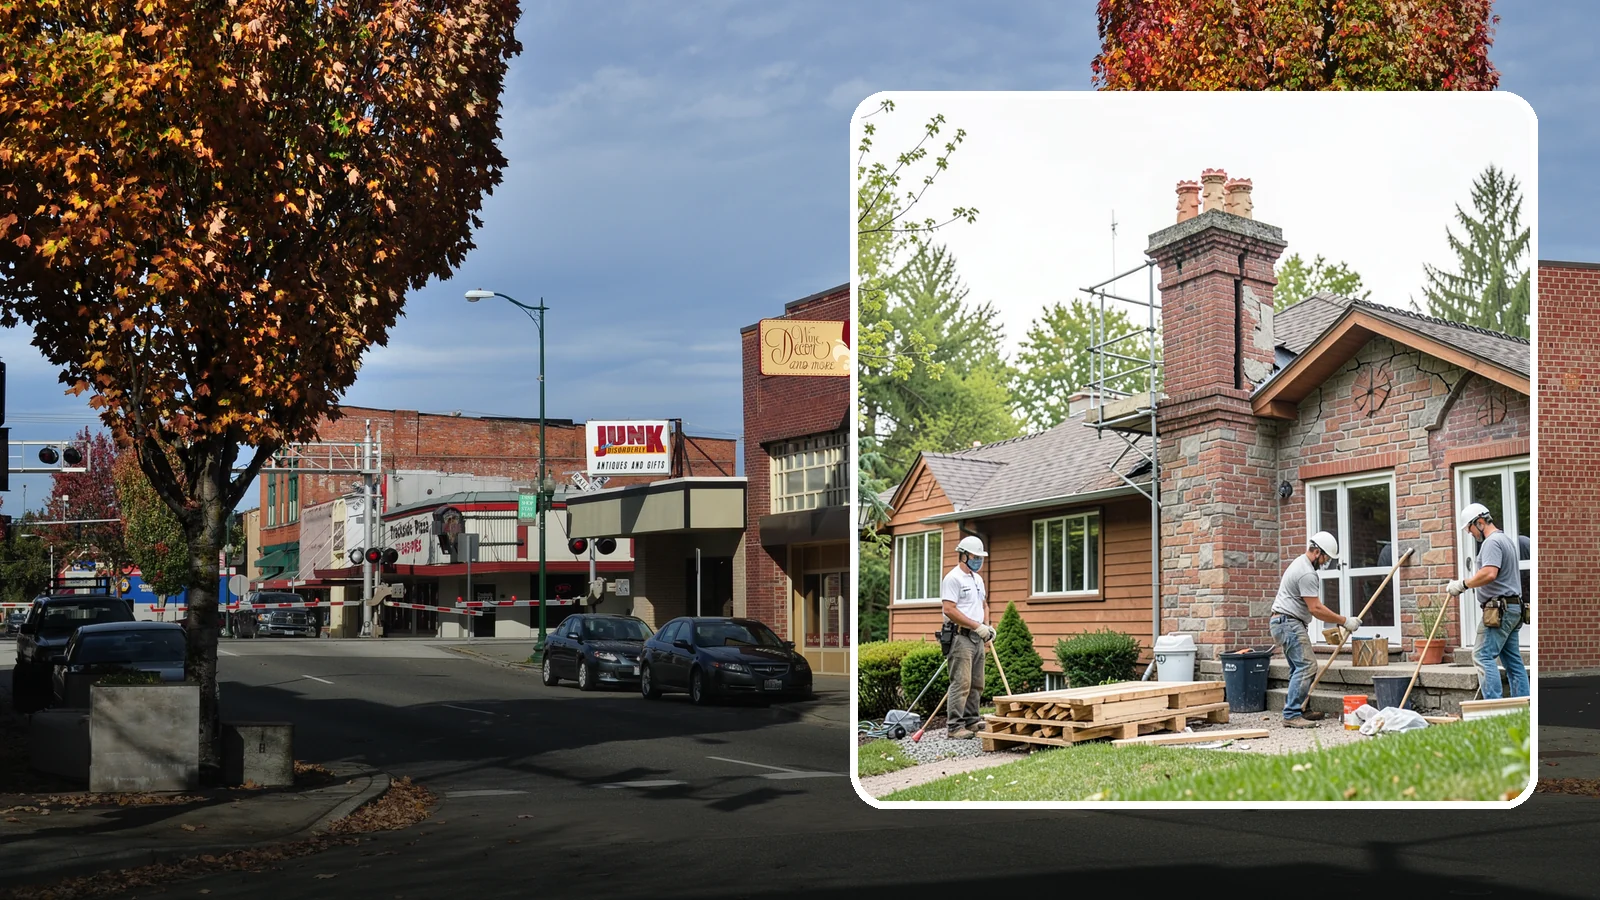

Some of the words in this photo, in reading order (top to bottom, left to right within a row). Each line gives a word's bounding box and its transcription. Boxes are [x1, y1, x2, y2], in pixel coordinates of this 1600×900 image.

[595, 425, 665, 457] JUNK
[607, 446, 646, 454] DISORDERLY
[596, 461, 628, 470] ANTIQUES
[631, 461, 644, 470] AND
[647, 460, 665, 469] GIFTS
[414, 519, 429, 534] Pizza
